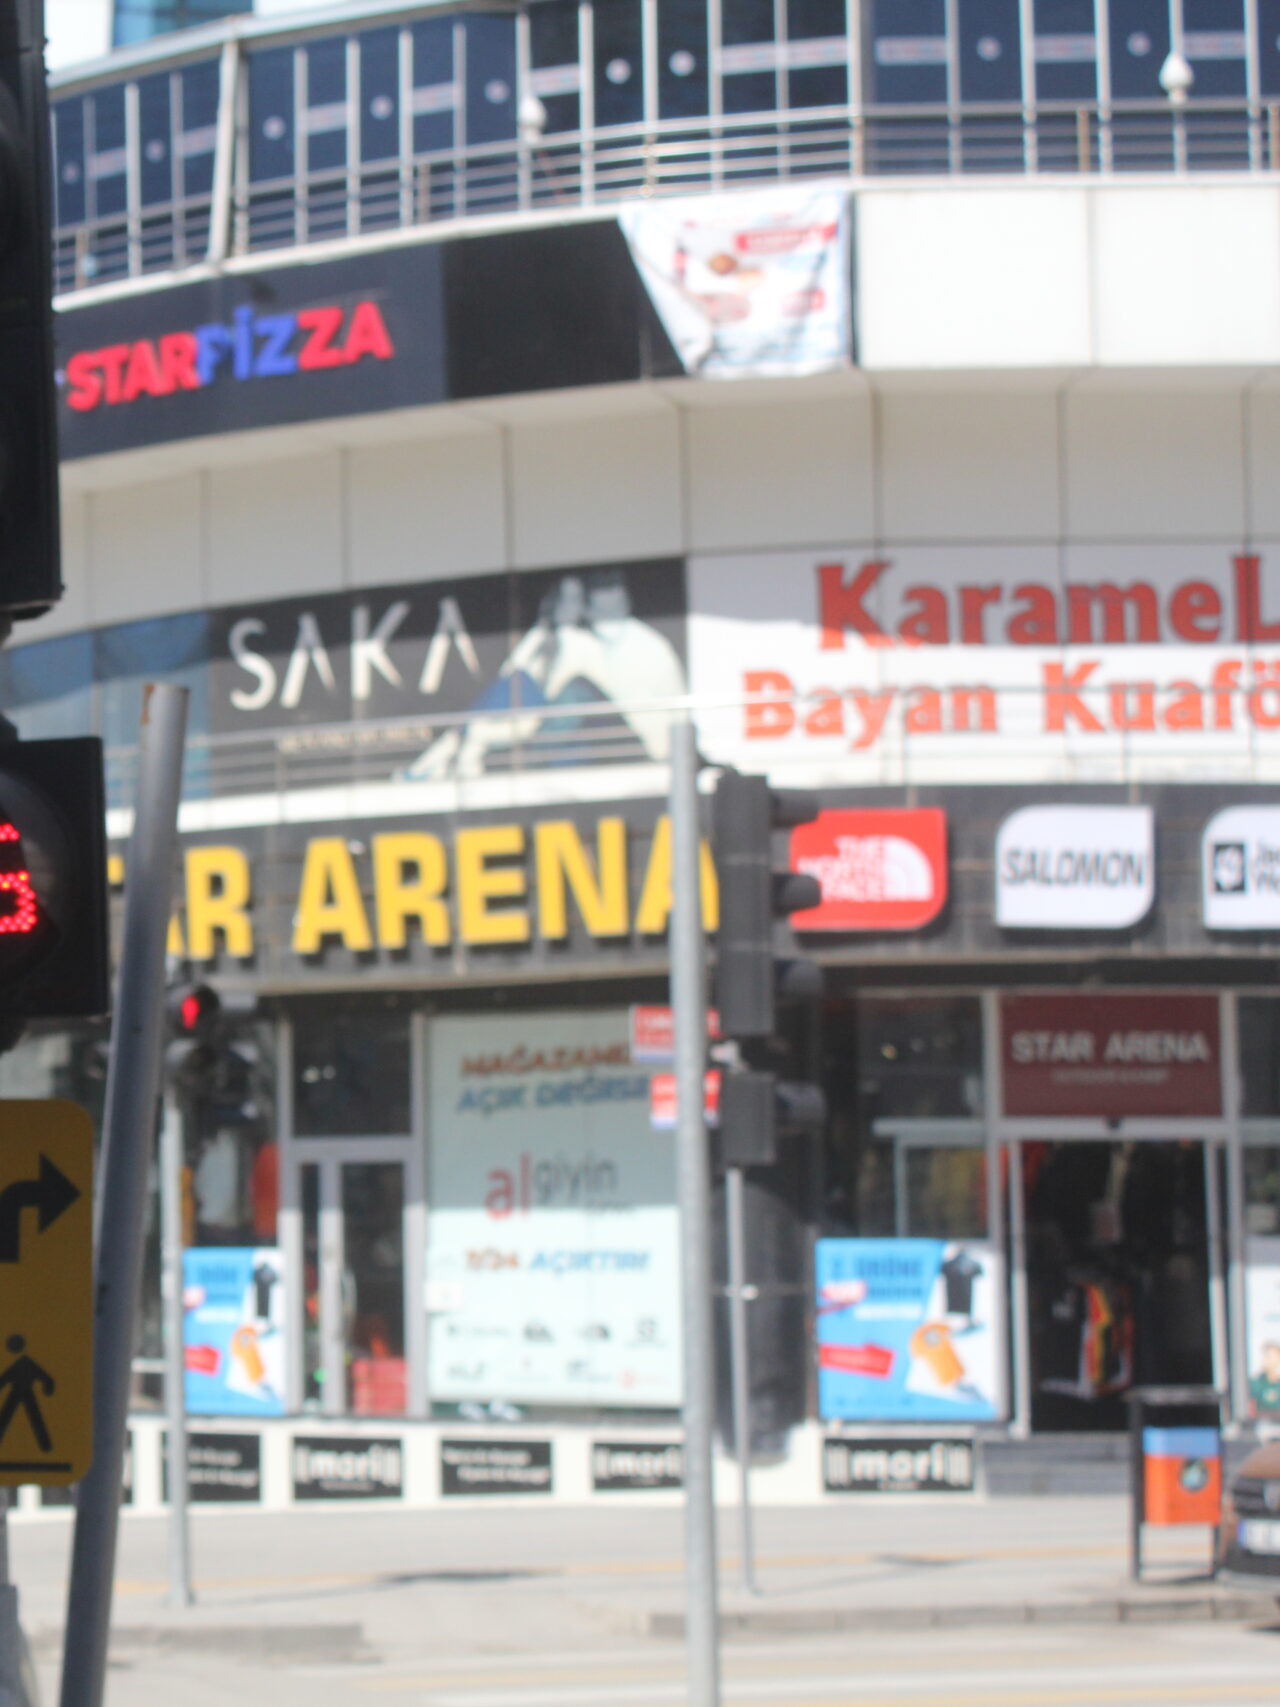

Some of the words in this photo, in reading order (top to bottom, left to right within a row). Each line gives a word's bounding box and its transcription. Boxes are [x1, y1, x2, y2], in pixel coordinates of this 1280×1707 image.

[228, 597, 483, 711] SAKA
[742, 670, 999, 752] Bayan
[292, 815, 719, 956] ARENA
[1005, 848, 1144, 886] SALOMON
[1011, 1029, 1095, 1064] STAR
[1103, 1029, 1211, 1064] ARENA
[851, 1441, 946, 1482] mori
